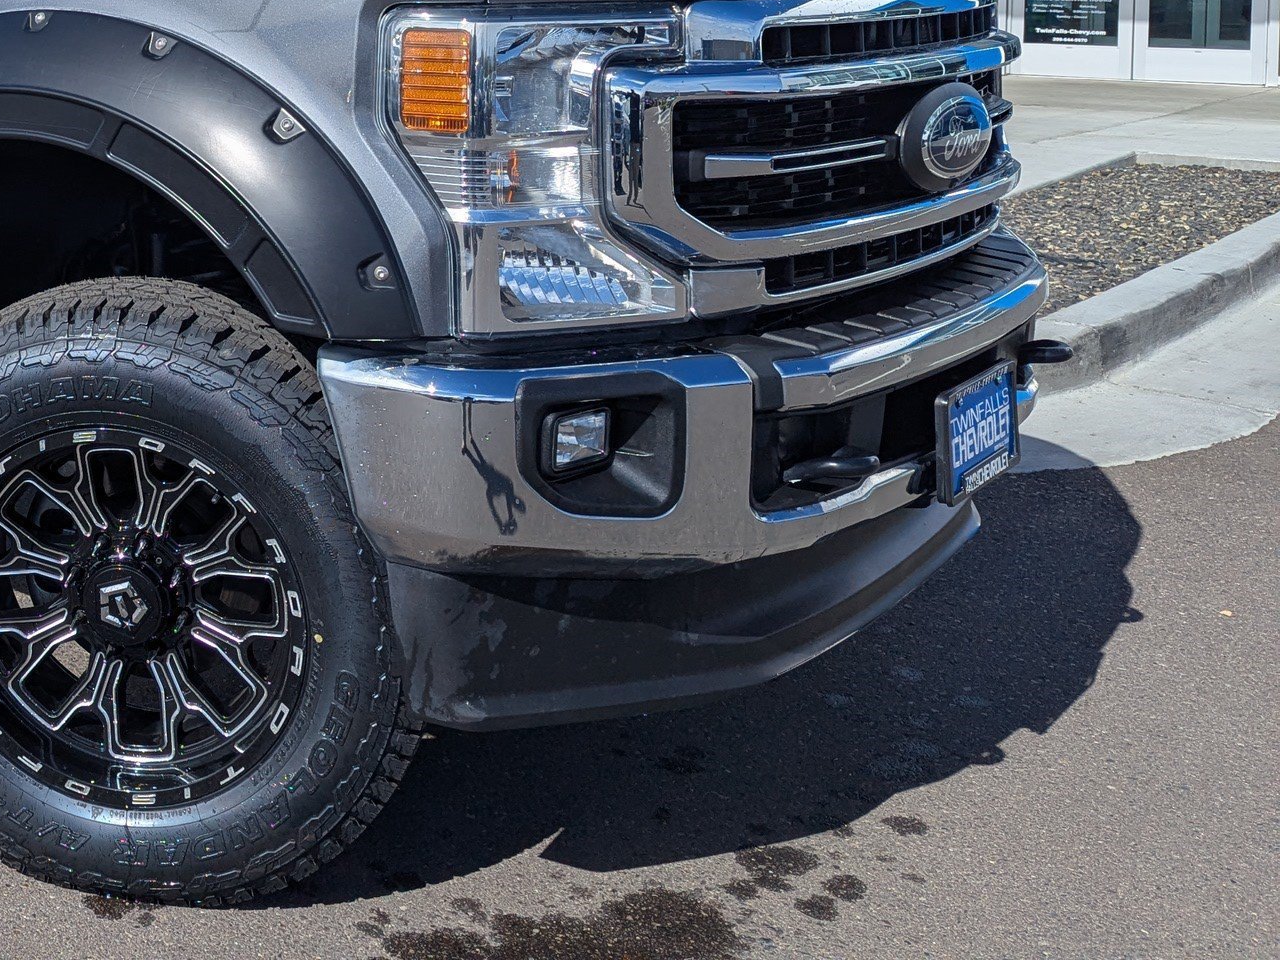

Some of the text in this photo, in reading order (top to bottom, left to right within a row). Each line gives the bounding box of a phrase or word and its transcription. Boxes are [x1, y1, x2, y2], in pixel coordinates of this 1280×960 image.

[943, 114, 981, 161] Ford
[950, 387, 1010, 437] TWINFALLS
[952, 404, 1010, 469] CHEVROLET
[977, 451, 1009, 486] CHEVROLET
[110, 670, 361, 868] GEOLANDAR
